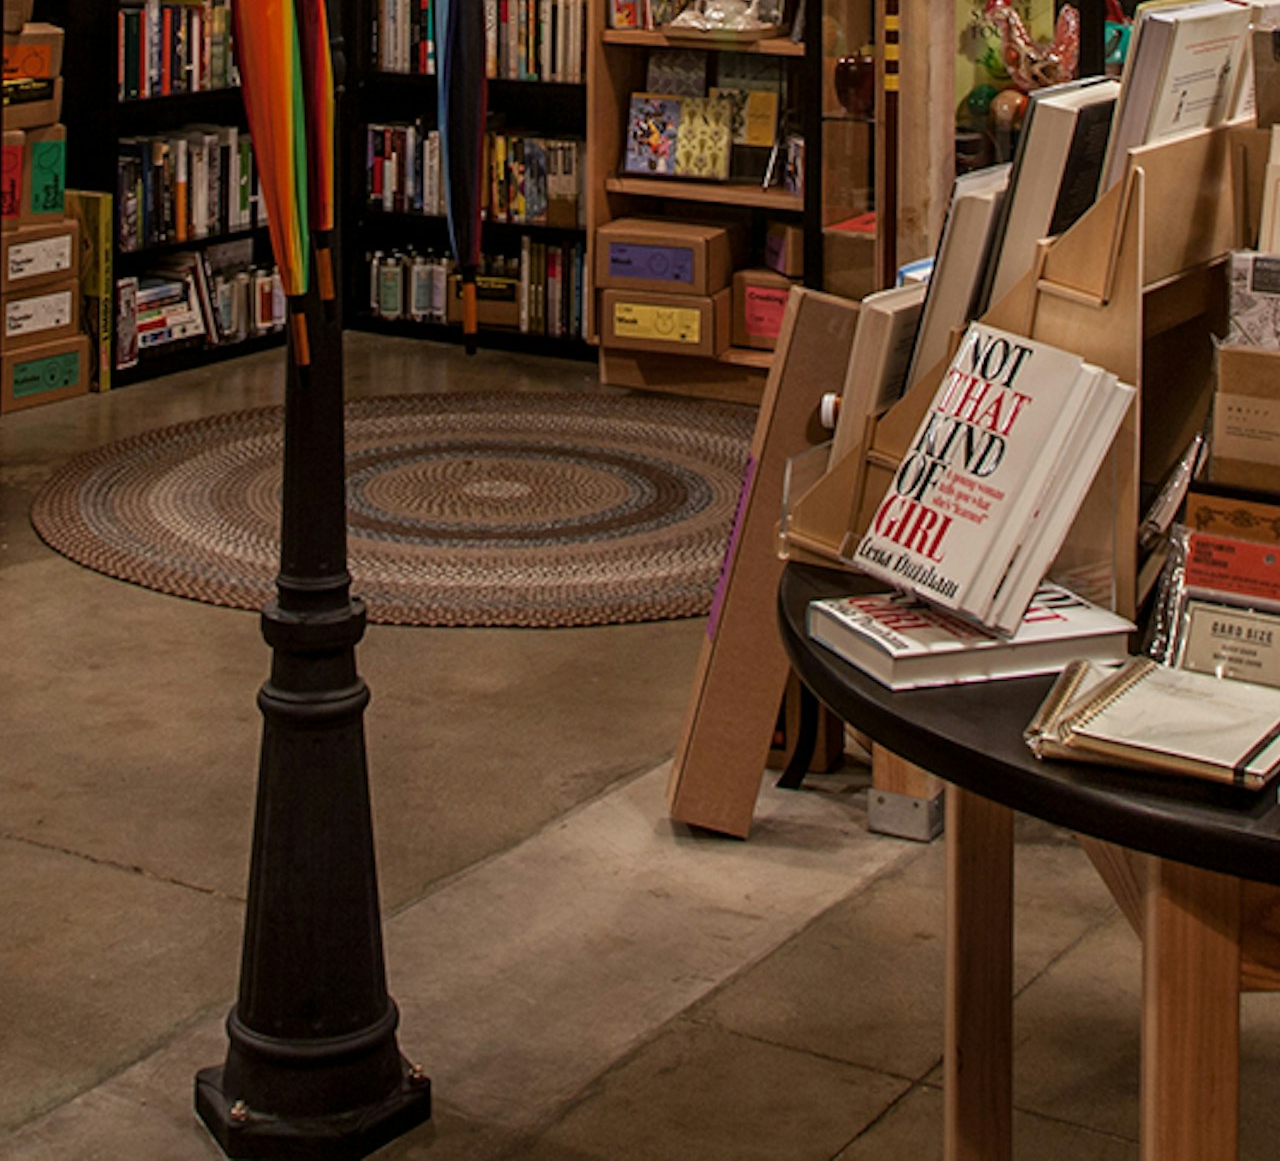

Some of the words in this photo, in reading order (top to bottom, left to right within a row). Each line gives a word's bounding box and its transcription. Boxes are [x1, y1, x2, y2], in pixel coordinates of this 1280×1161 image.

[952, 328, 1033, 389] NOT
[937, 369, 1032, 437] THAT
[915, 410, 1006, 478] KIND
[896, 451, 947, 502] OF
[873, 493, 953, 564] GIRL
[858, 537, 894, 567] Lena
[891, 550, 960, 600] Dunham
[1211, 622, 1243, 639] CARD
[1247, 626, 1274, 644] SIZE
